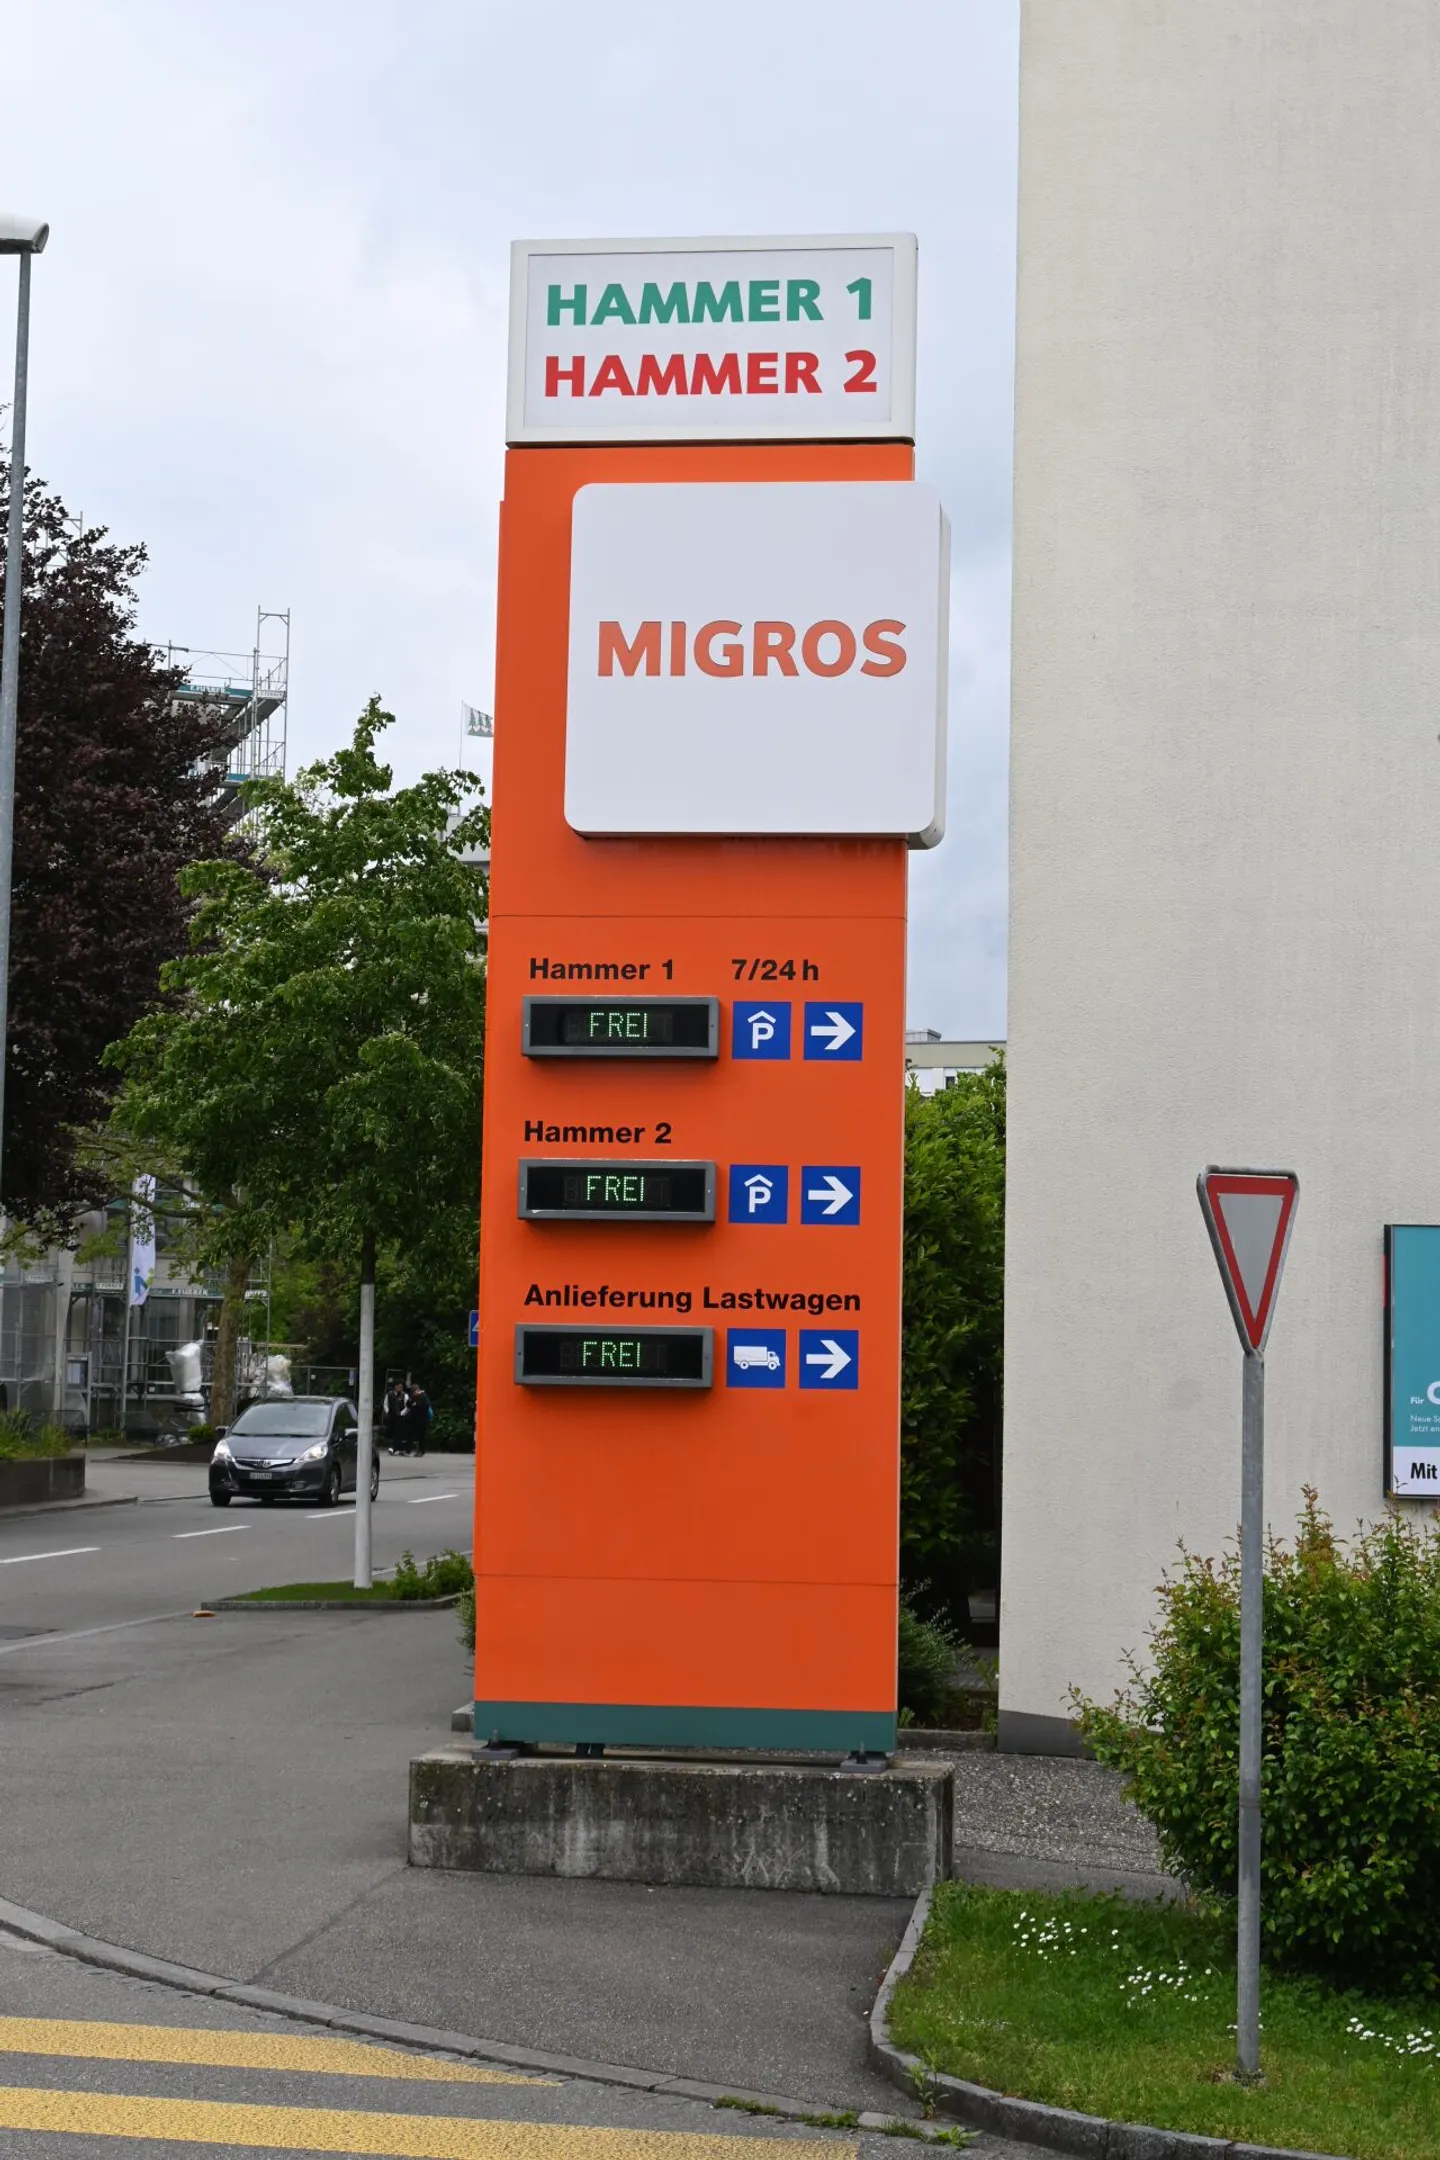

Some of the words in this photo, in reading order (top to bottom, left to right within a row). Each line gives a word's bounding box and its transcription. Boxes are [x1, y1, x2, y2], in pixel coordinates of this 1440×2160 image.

[546, 279, 823, 327] HAMMER
[847, 277, 873, 321] 1
[544, 350, 822, 398] HAMMER
[843, 350, 877, 393] 2
[598, 619, 907, 678] MIGROS
[530, 957, 651, 980] Hammer
[662, 959, 673, 980] 1
[589, 1012, 648, 1038] FREI
[524, 1120, 645, 1143] Hammer
[654, 1122, 672, 1144] 2
[586, 1175, 645, 1202] FREI
[524, 1284, 692, 1313] Anlieferung
[703, 1286, 861, 1316] Lastwagen
[582, 1340, 641, 1368] FREI
[1410, 1414, 1431, 1423] Neue
[1410, 1424, 1428, 1432] Jetzt
[1410, 1462, 1438, 1480] Mit
